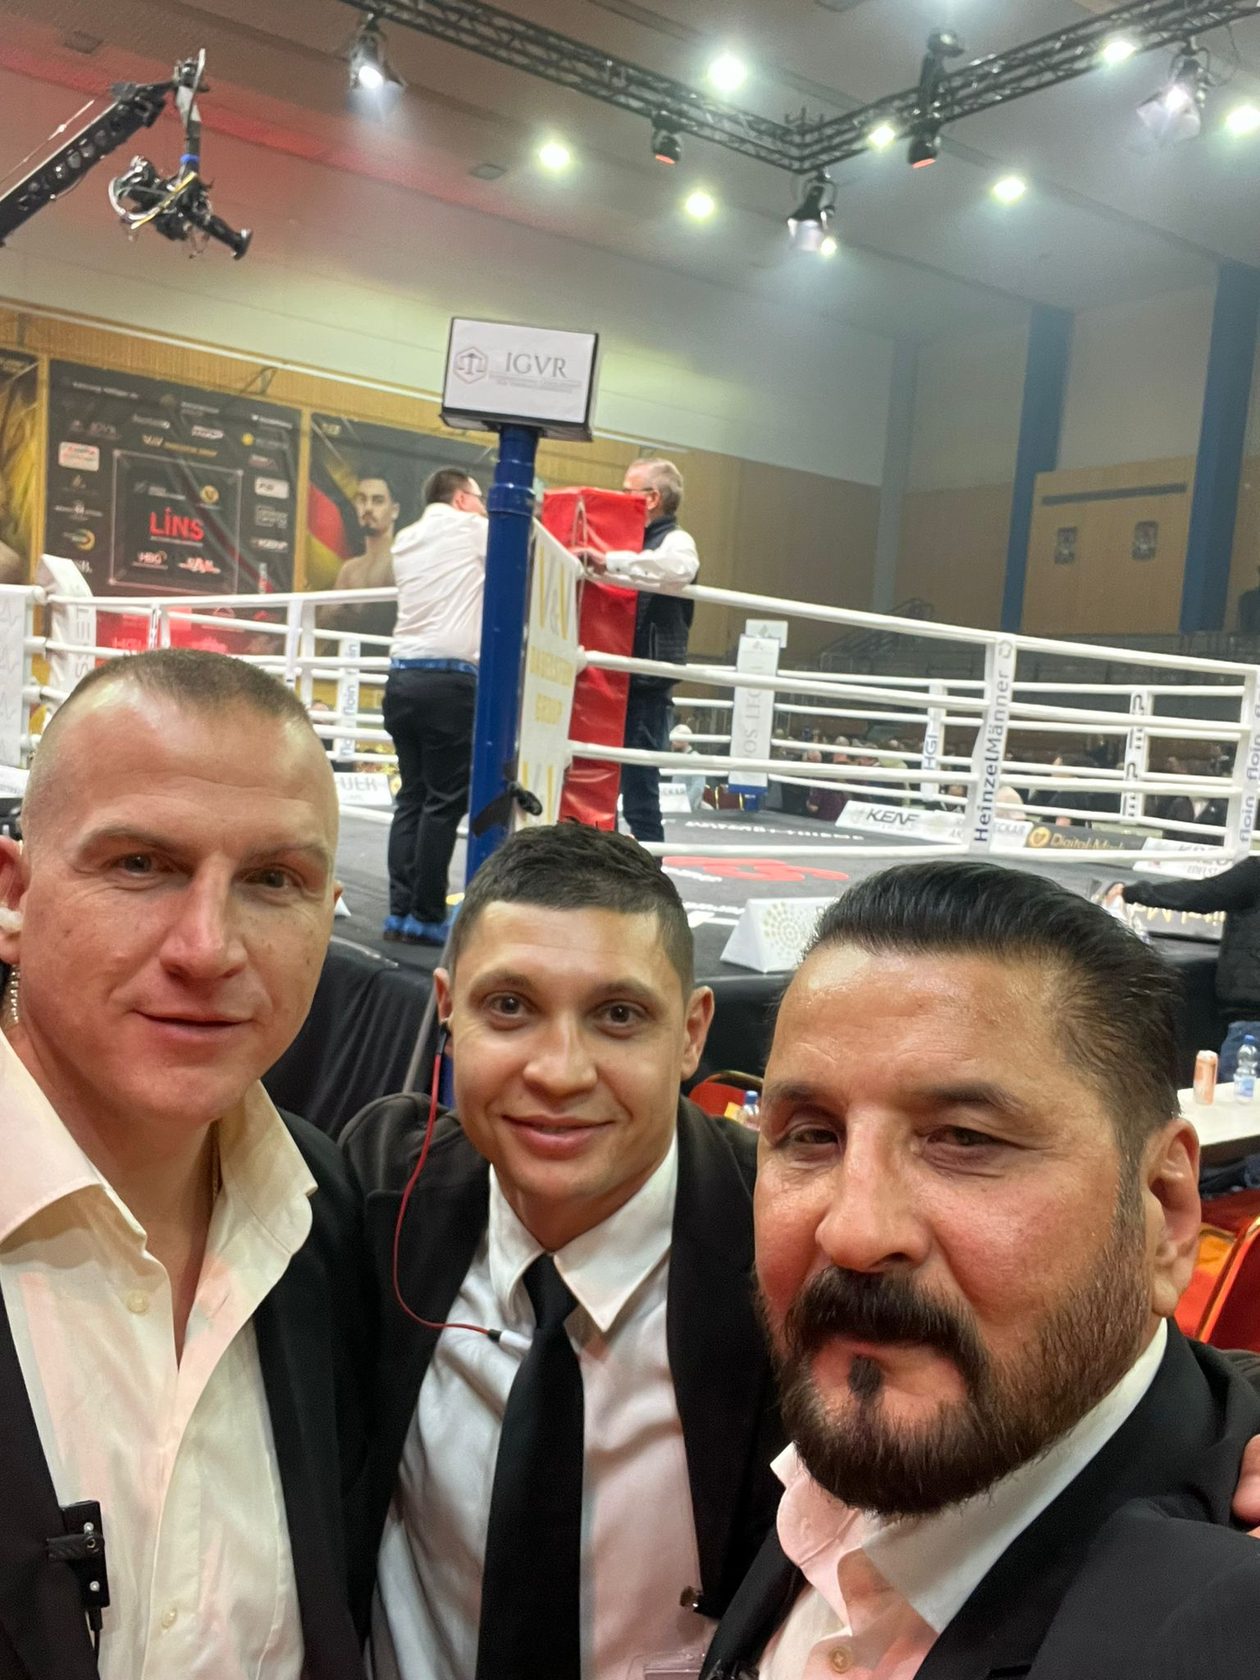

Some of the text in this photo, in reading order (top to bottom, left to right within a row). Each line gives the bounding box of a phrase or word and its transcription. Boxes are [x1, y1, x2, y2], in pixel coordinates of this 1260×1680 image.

[505, 351, 568, 379] IGVR
[974, 670, 1010, 842] HeinzelMänner
[1239, 796, 1255, 842] floin
